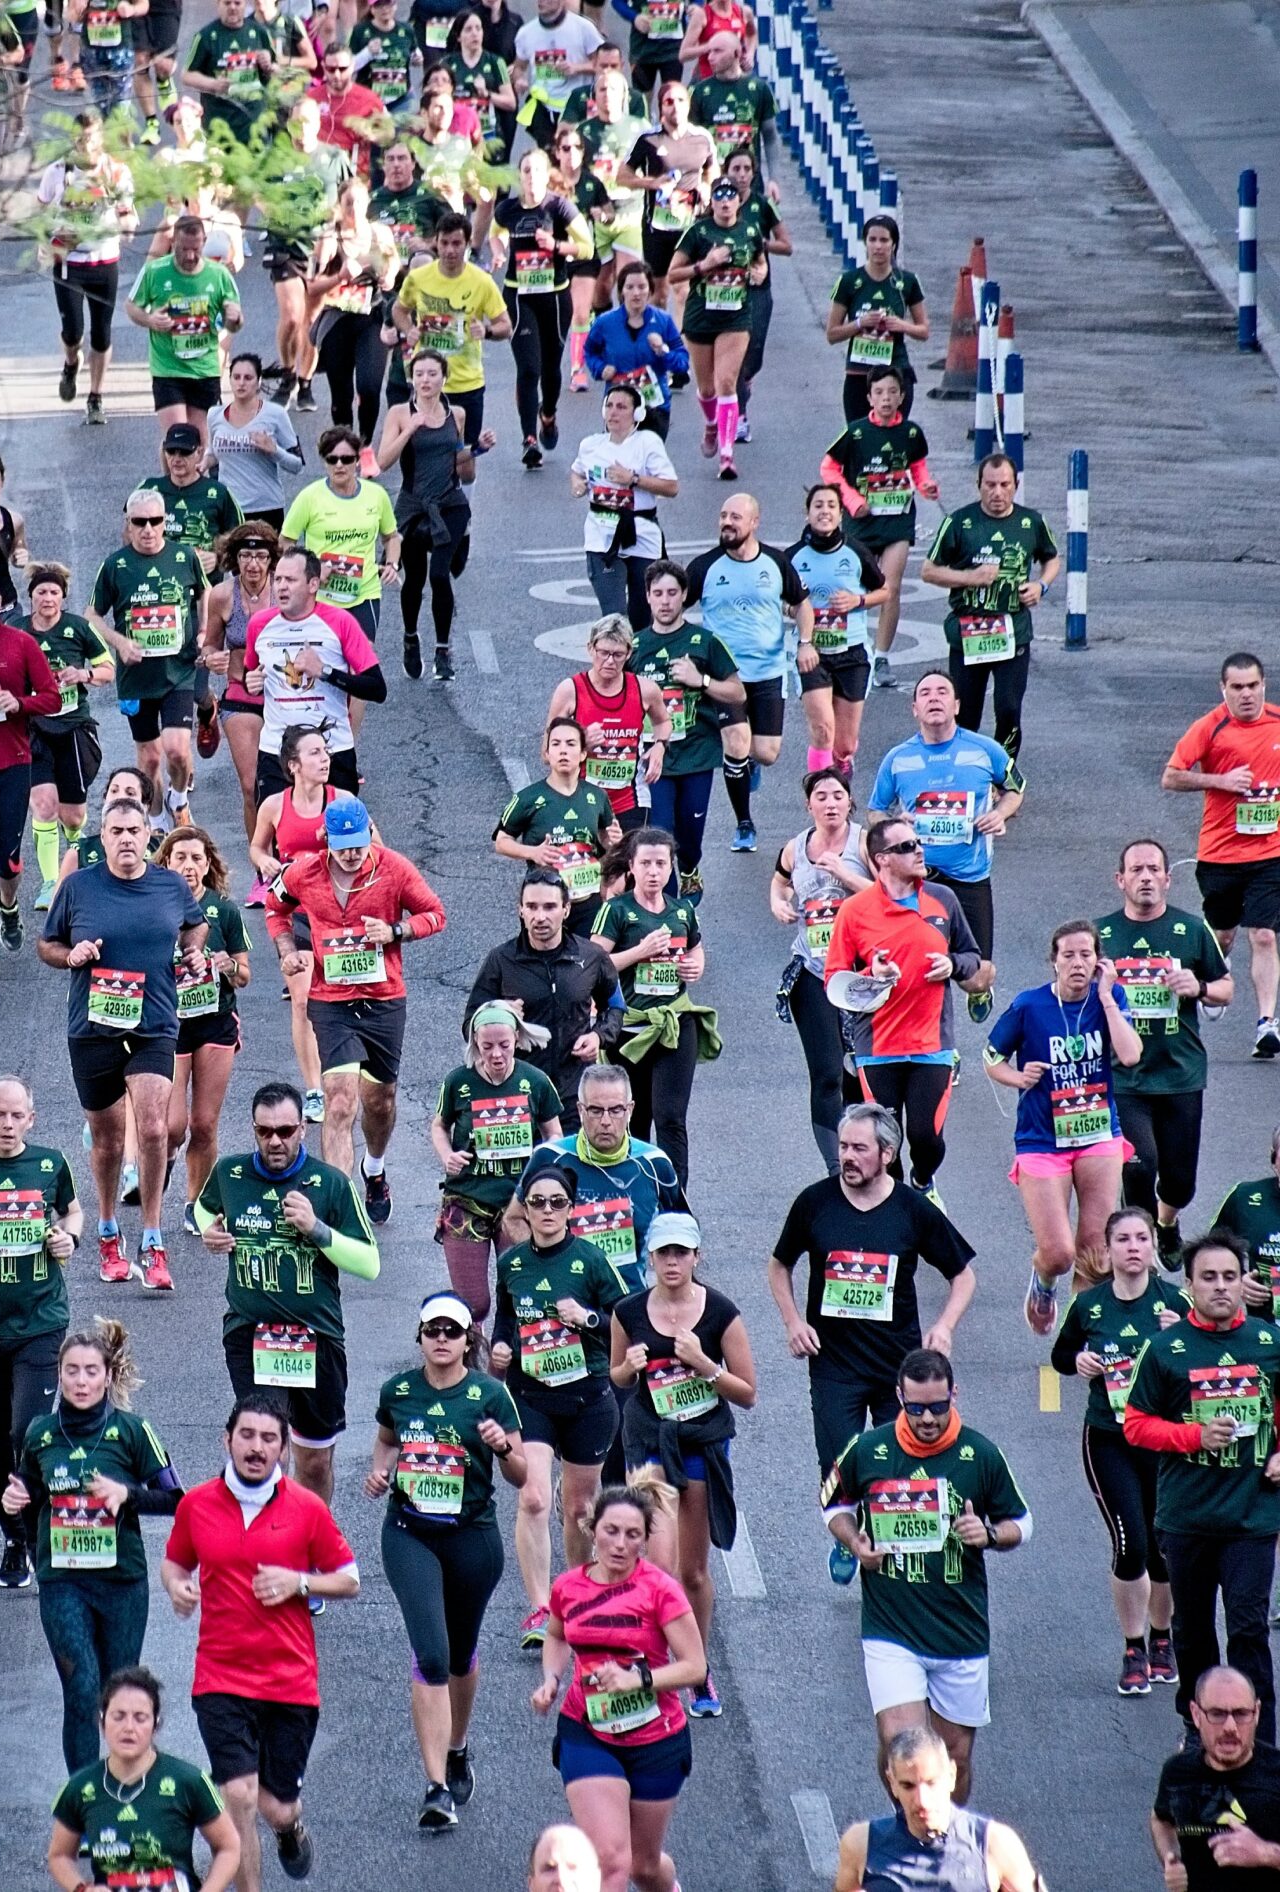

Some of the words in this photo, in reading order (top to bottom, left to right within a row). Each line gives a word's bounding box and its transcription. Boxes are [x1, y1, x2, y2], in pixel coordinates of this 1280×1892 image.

[130, 593, 158, 603] MADRID
[147, 634, 170, 646] 40802
[978, 639, 1001, 651] 43105
[602, 728, 638, 739] NMARK
[931, 820, 955, 833] 26301
[341, 958, 368, 973] 43163
[181, 994, 207, 1006] 40901
[1134, 993, 1163, 1005] 42954
[104, 1002, 131, 1017] 42936
[1052, 1064, 1078, 1082] FOR
[1079, 1060, 1102, 1076] THE
[235, 1218, 272, 1230] MADRID
[2, 1229, 33, 1242] 41756
[251, 1259, 260, 1281] 2017
[843, 1289, 874, 1305] 42572
[273, 1359, 303, 1373] 41644
[400, 1431, 435, 1443] MADRID
[48, 1478, 80, 1493] MADRID
[894, 1521, 927, 1537] 42659
